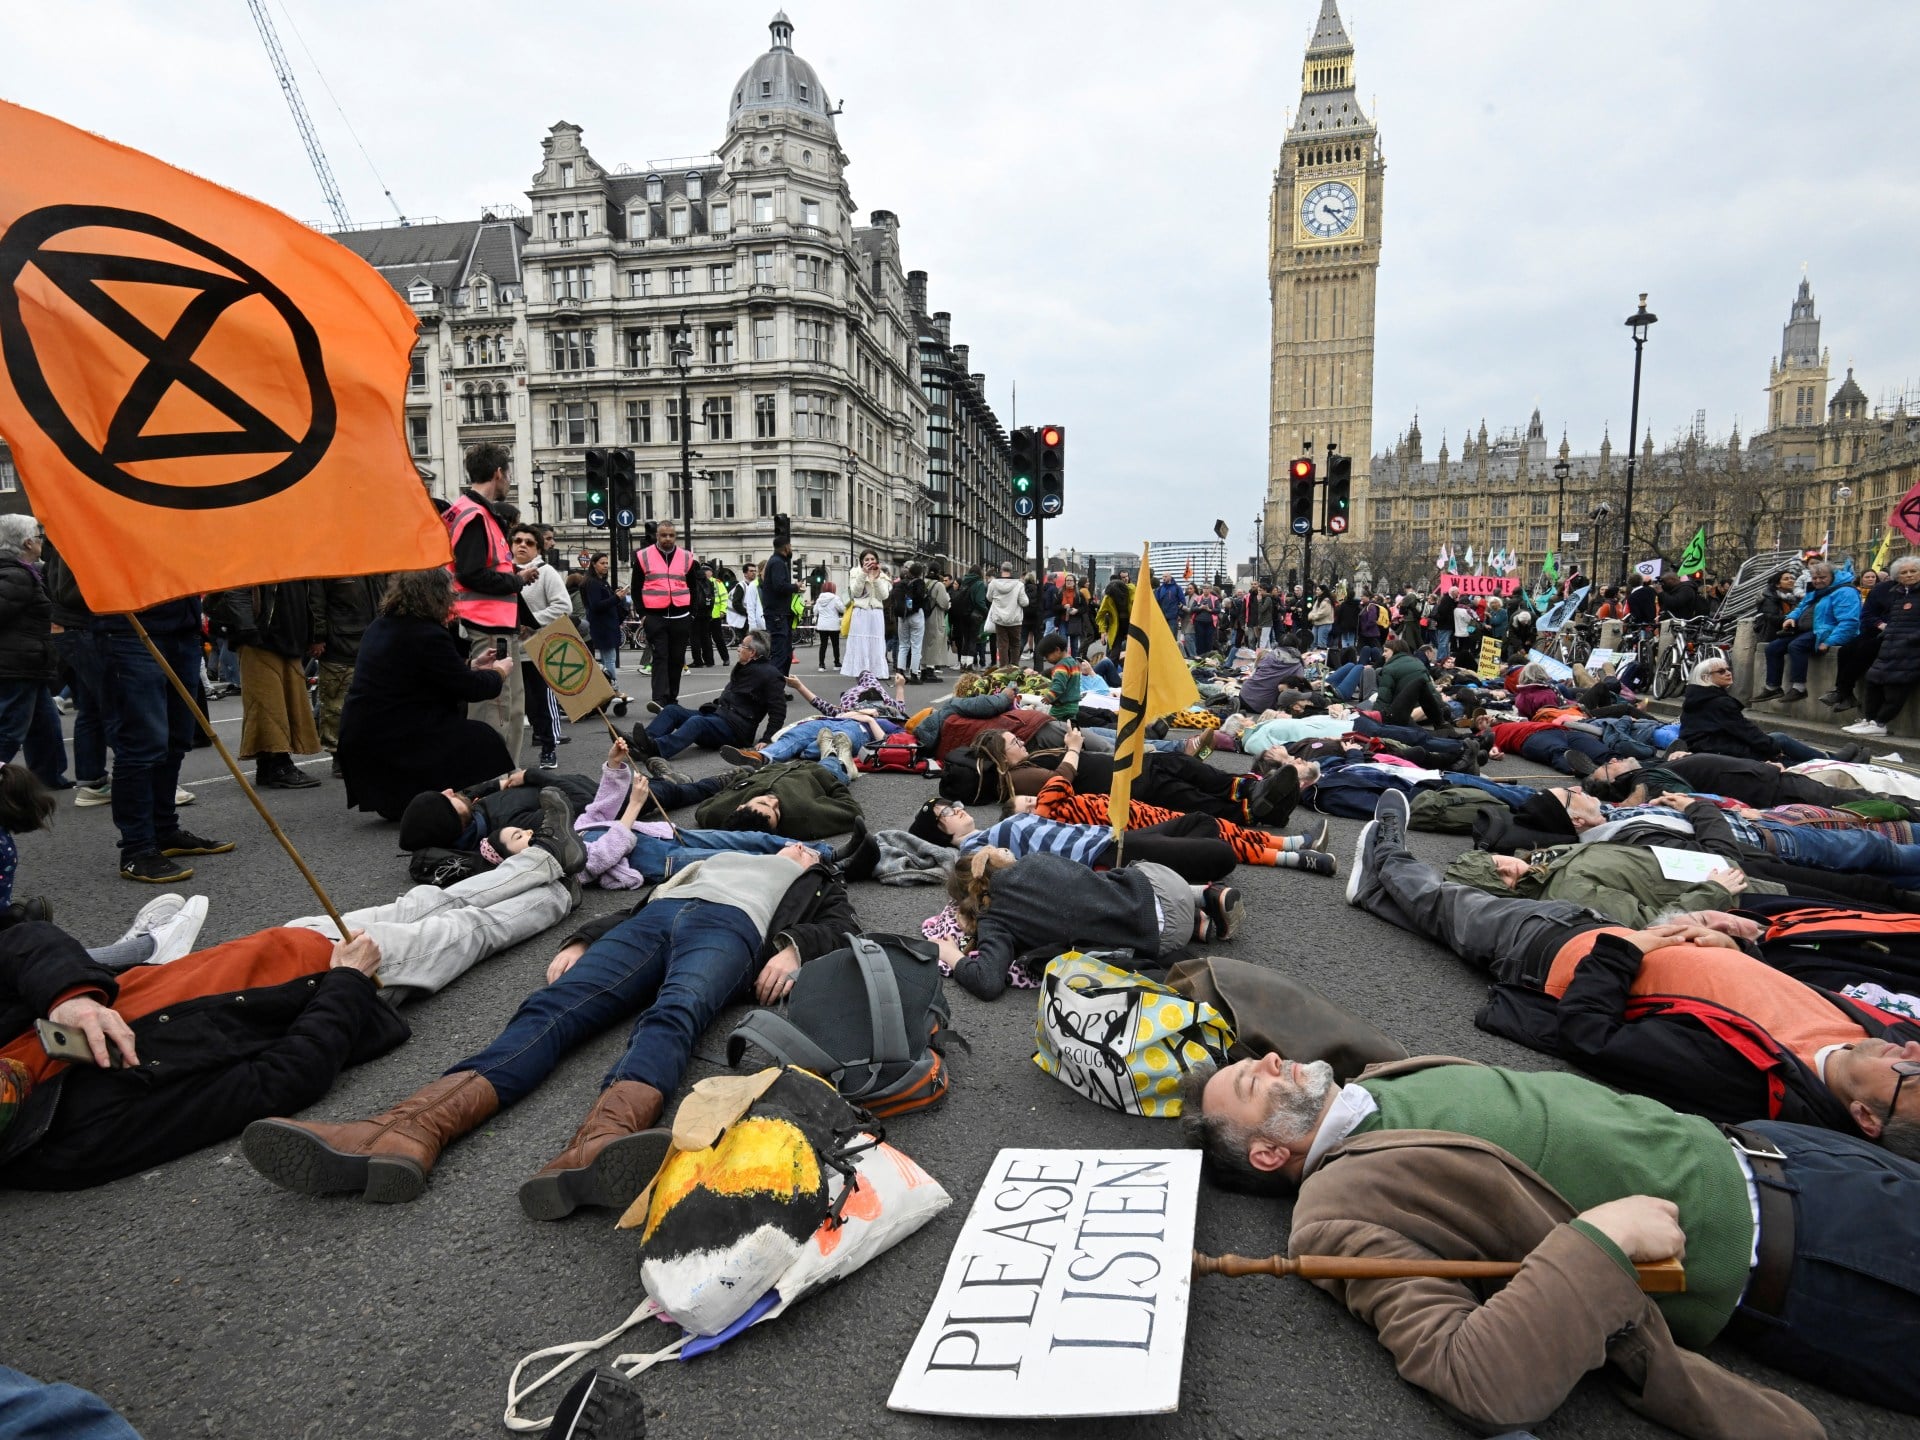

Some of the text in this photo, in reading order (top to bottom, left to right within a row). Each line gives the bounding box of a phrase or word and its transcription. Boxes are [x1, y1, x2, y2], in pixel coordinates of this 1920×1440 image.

[1451, 577, 1511, 593] WELCOME
[1064, 1046, 1122, 1072] BOUG
[925, 1160, 1083, 1380] PLEASE
[1049, 1159, 1171, 1355] LISTEN
